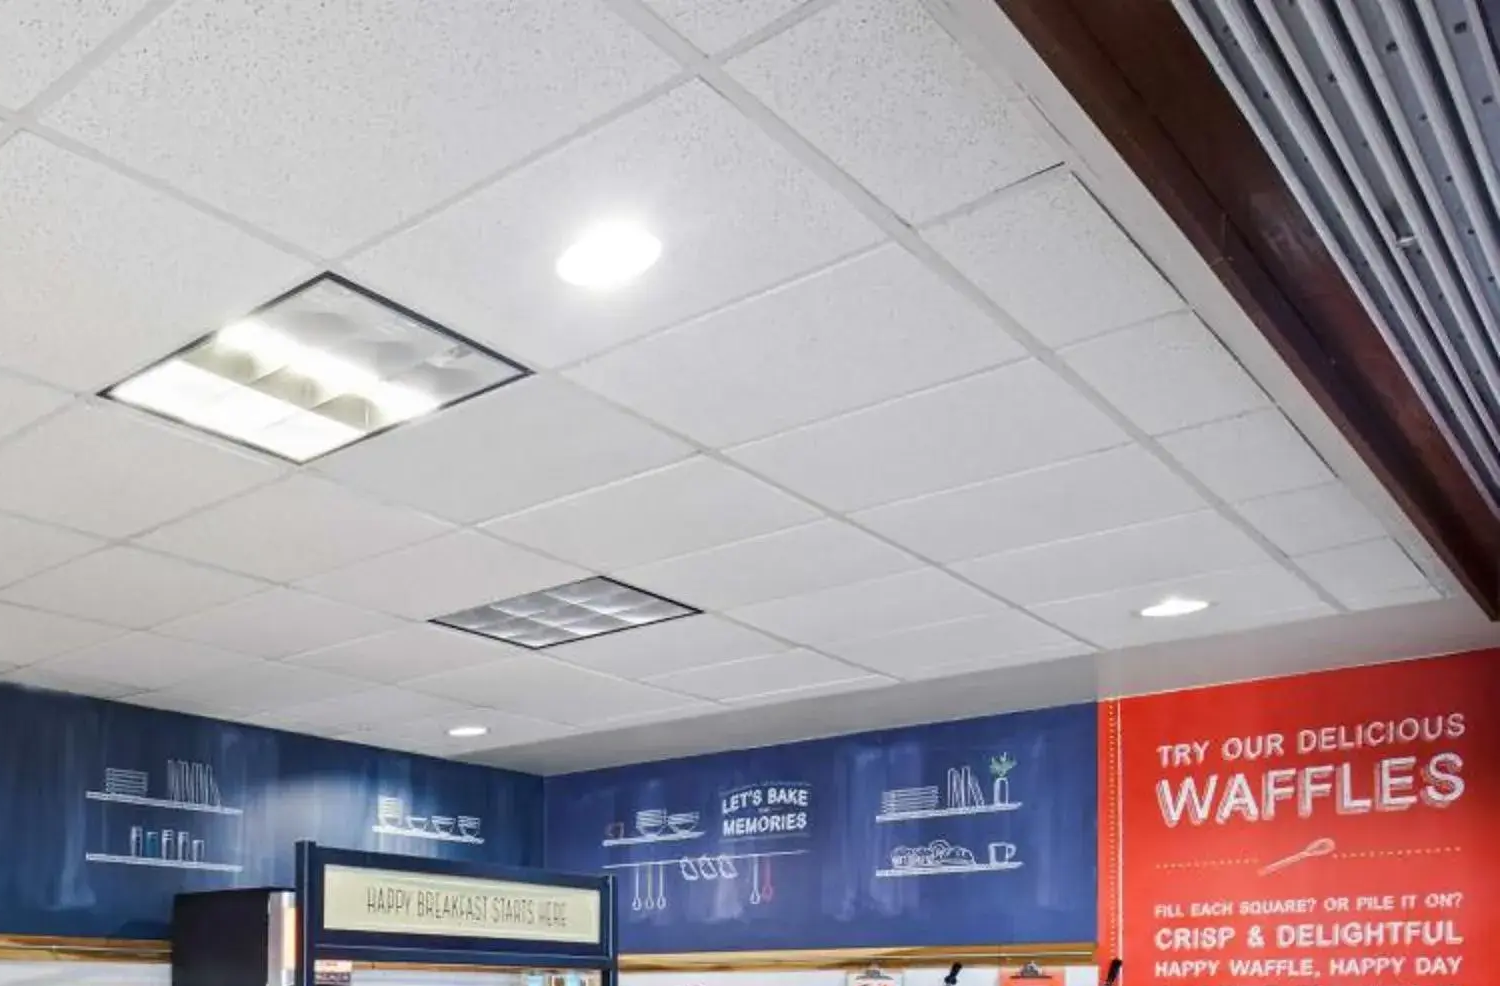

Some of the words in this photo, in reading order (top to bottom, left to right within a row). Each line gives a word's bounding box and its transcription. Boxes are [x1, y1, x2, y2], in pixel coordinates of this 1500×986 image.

[1157, 741, 1209, 768] TRY
[1221, 733, 1284, 760] OUR
[1298, 713, 1466, 754] DELICIOUS
[722, 789, 762, 814] LET'S
[767, 787, 809, 807] BAKE
[1156, 752, 1465, 828] WAFFLES
[723, 812, 807, 836] MEMORIES
[367, 886, 411, 914] HAPPY
[417, 890, 488, 922] BREAKFAST
[491, 896, 534, 925] STARTS
[1155, 904, 1184, 918] FILL
[1191, 901, 1233, 916] EACH
[1239, 898, 1316, 915] SQUARE?
[1324, 897, 1349, 912] OR
[1357, 895, 1394, 911] PILE
[1402, 894, 1416, 909] IT
[1425, 892, 1463, 908] ON?
[1155, 927, 1235, 950] CRISP
[1247, 925, 1265, 948] &
[1277, 920, 1463, 947] DELIGHTFUL
[1155, 960, 1220, 977] HAPPY
[1230, 959, 1320, 977] WAFFLE,
[1330, 957, 1405, 975] HAPPY
[1415, 956, 1462, 975] DAY
